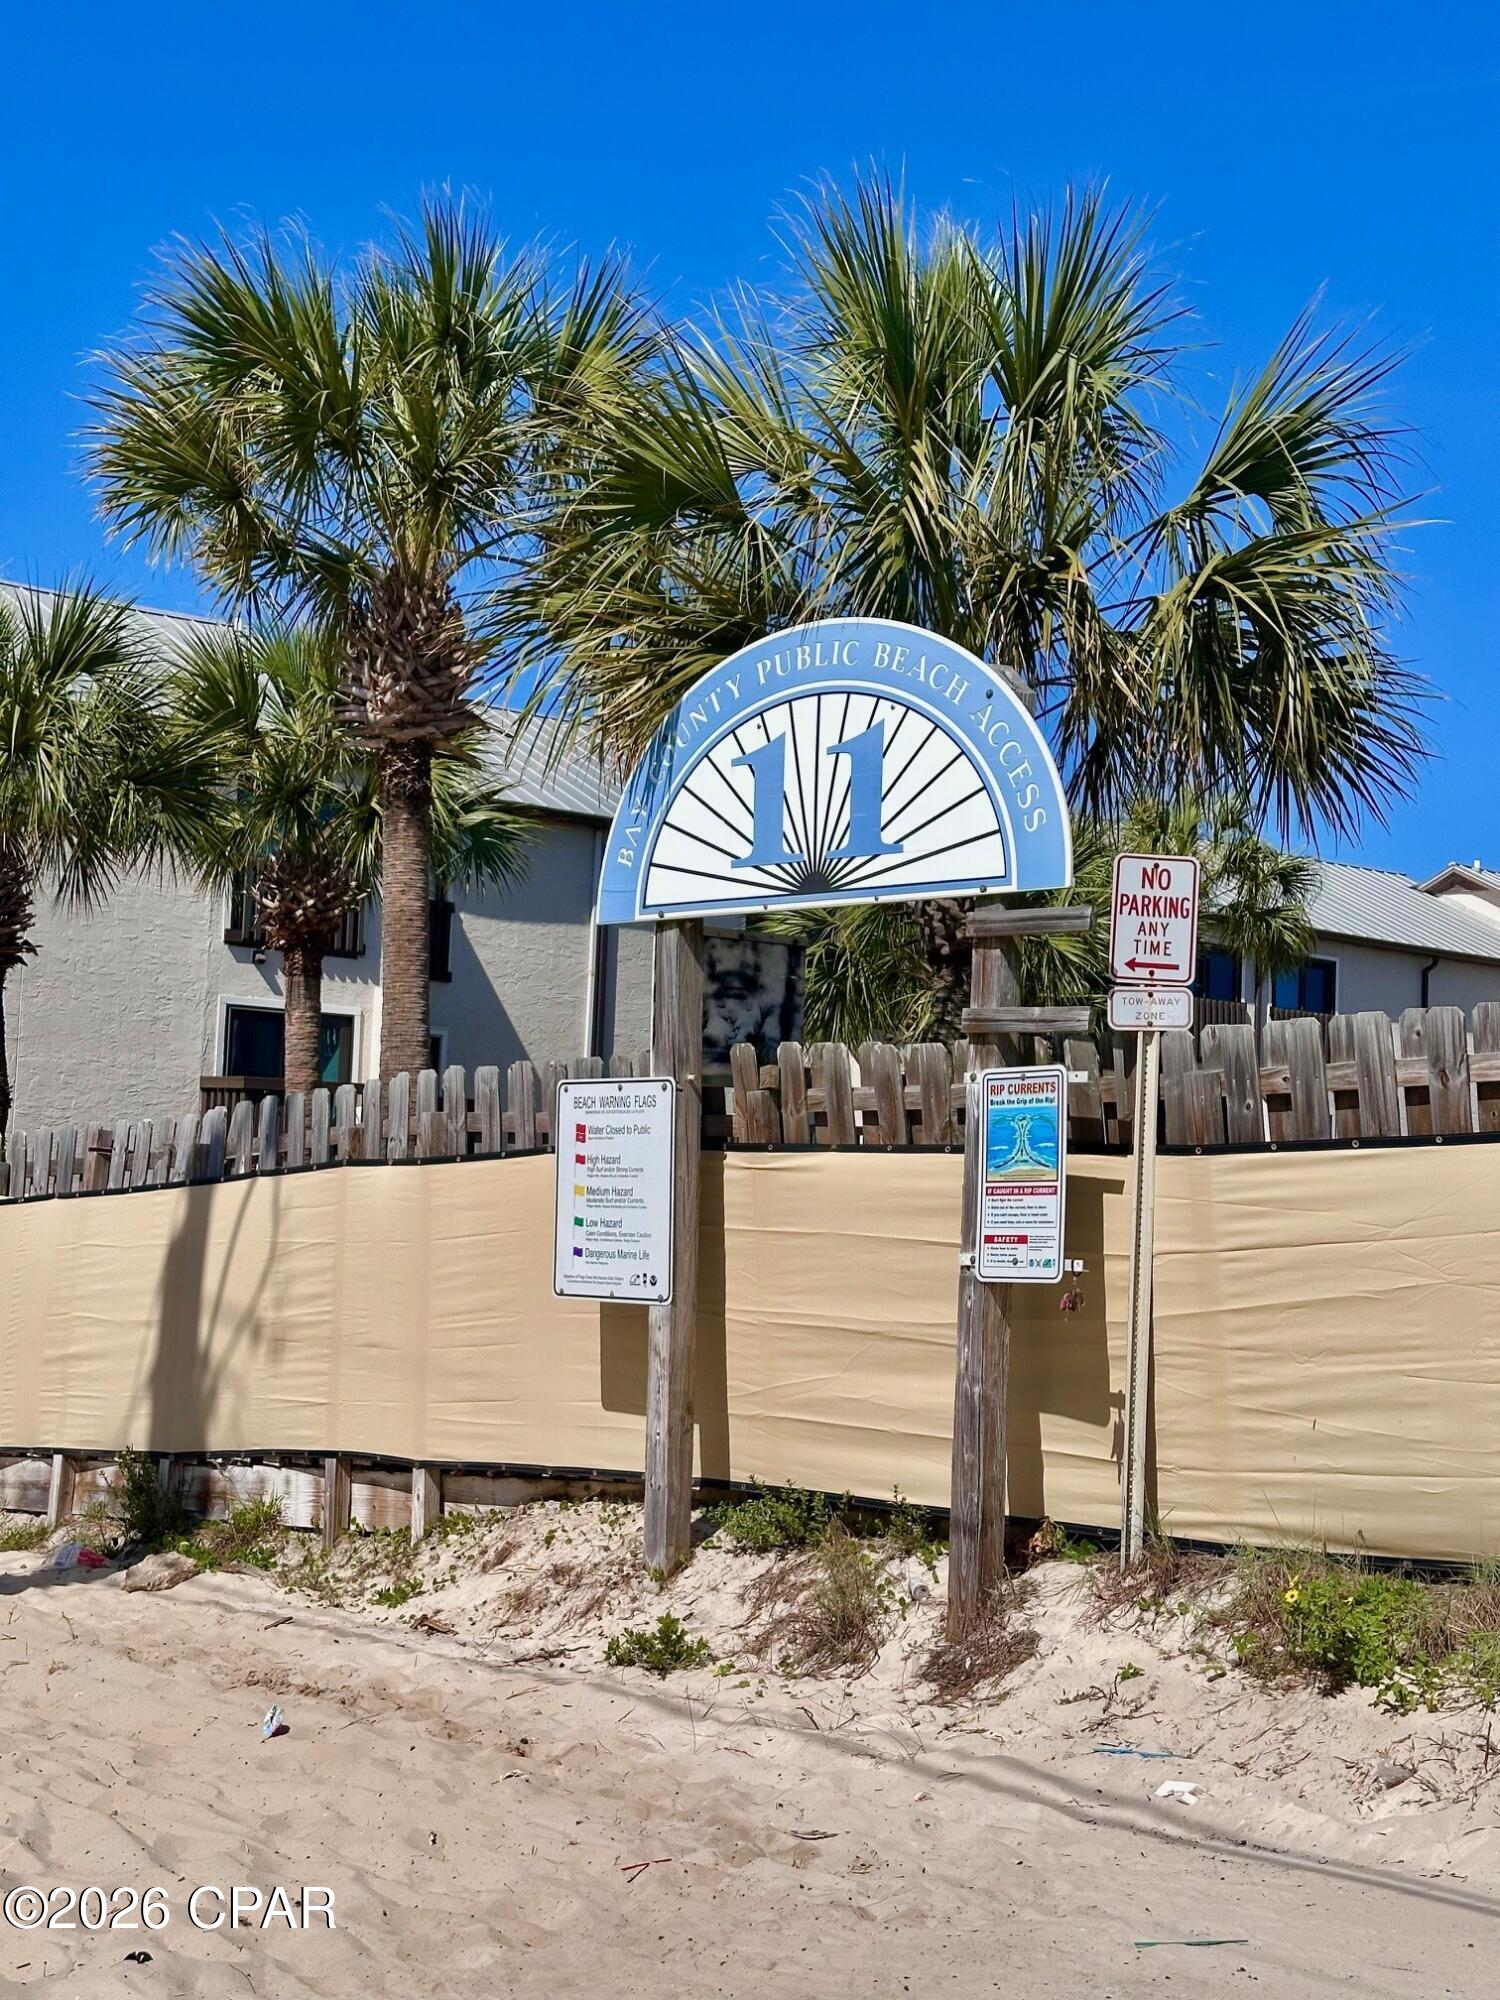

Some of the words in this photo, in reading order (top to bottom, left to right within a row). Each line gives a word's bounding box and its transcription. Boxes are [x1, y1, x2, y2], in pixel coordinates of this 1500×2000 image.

[617, 796, 648, 868] BAY
[651, 673, 742, 785] COUNTY
[756, 640, 860, 686] PUBLIC
[873, 641, 970, 706] BEACH
[970, 703, 1047, 833] ACCESS
[731, 718, 904, 869] 11
[1141, 867, 1172, 891] NO
[1119, 893, 1190, 919] PARKING
[1137, 920, 1170, 937] ANY
[1133, 939, 1172, 956] TIME
[1121, 996, 1181, 1007] TOW-AWAY
[1135, 1011, 1166, 1021] ZONE
[990, 1084, 1005, 1096] RIP
[1007, 1081, 1056, 1095] CURRENTS
[573, 1096, 596, 1109] BEACH
[599, 1095, 631, 1108] WARNING
[634, 1094, 657, 1108] FLAGS
[1016, 1098, 1027, 1106] Grip
[588, 1125, 604, 1135] Water
[605, 1124, 626, 1135] Closed
[626, 1125, 632, 1135] to
[633, 1124, 651, 1135] Public
[586, 1154, 600, 1167] High
[600, 1154, 621, 1165] Hazard
[586, 1186, 610, 1196] Medium
[611, 1186, 634, 1197] Hazard
[585, 1218, 598, 1228] Low
[600, 1218, 623, 1228] Hazard
[585, 1248, 616, 1260] Dangerous
[617, 1249, 638, 1260] Marine
[639, 1250, 650, 1260] Life
